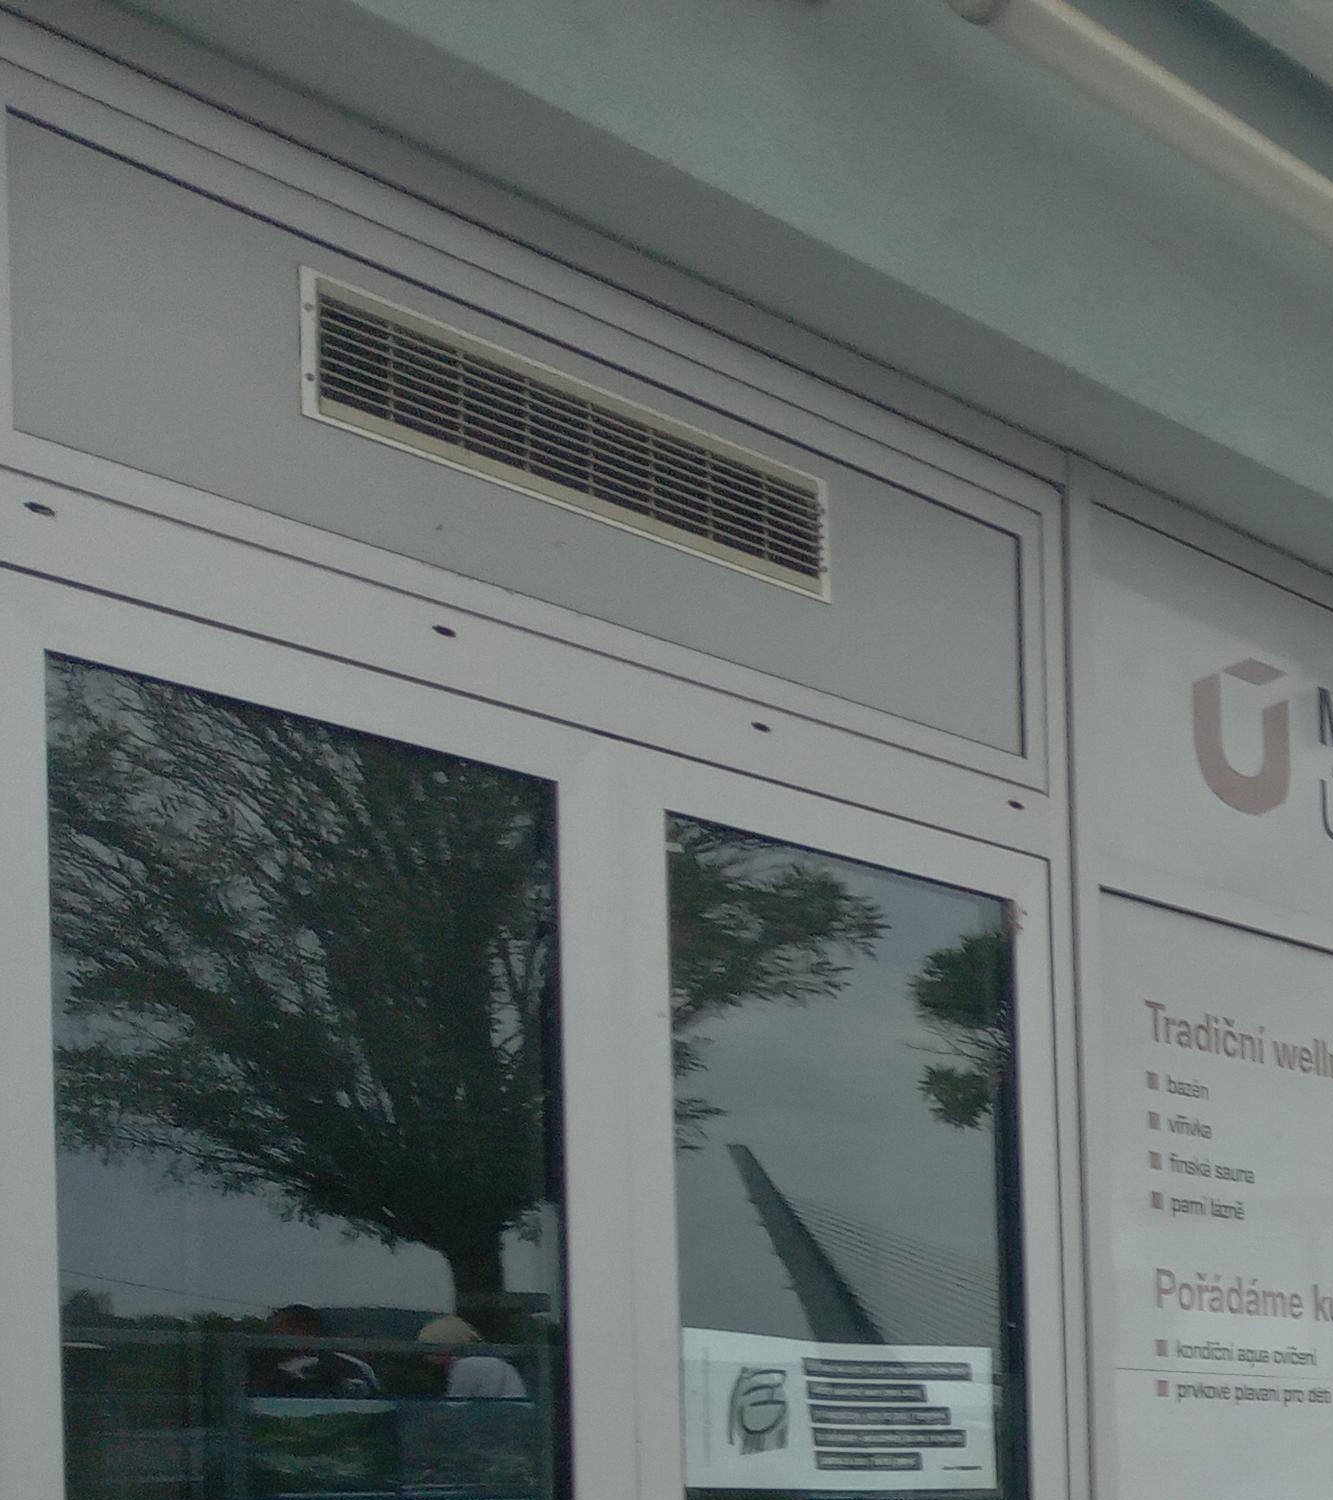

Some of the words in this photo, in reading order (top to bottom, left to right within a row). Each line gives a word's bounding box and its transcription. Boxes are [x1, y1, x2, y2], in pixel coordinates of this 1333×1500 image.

[1145, 999, 1265, 1064] Tradiční
[1215, 1164, 1256, 1184] sauna
[1155, 1268, 1304, 1319] Pořádáme
